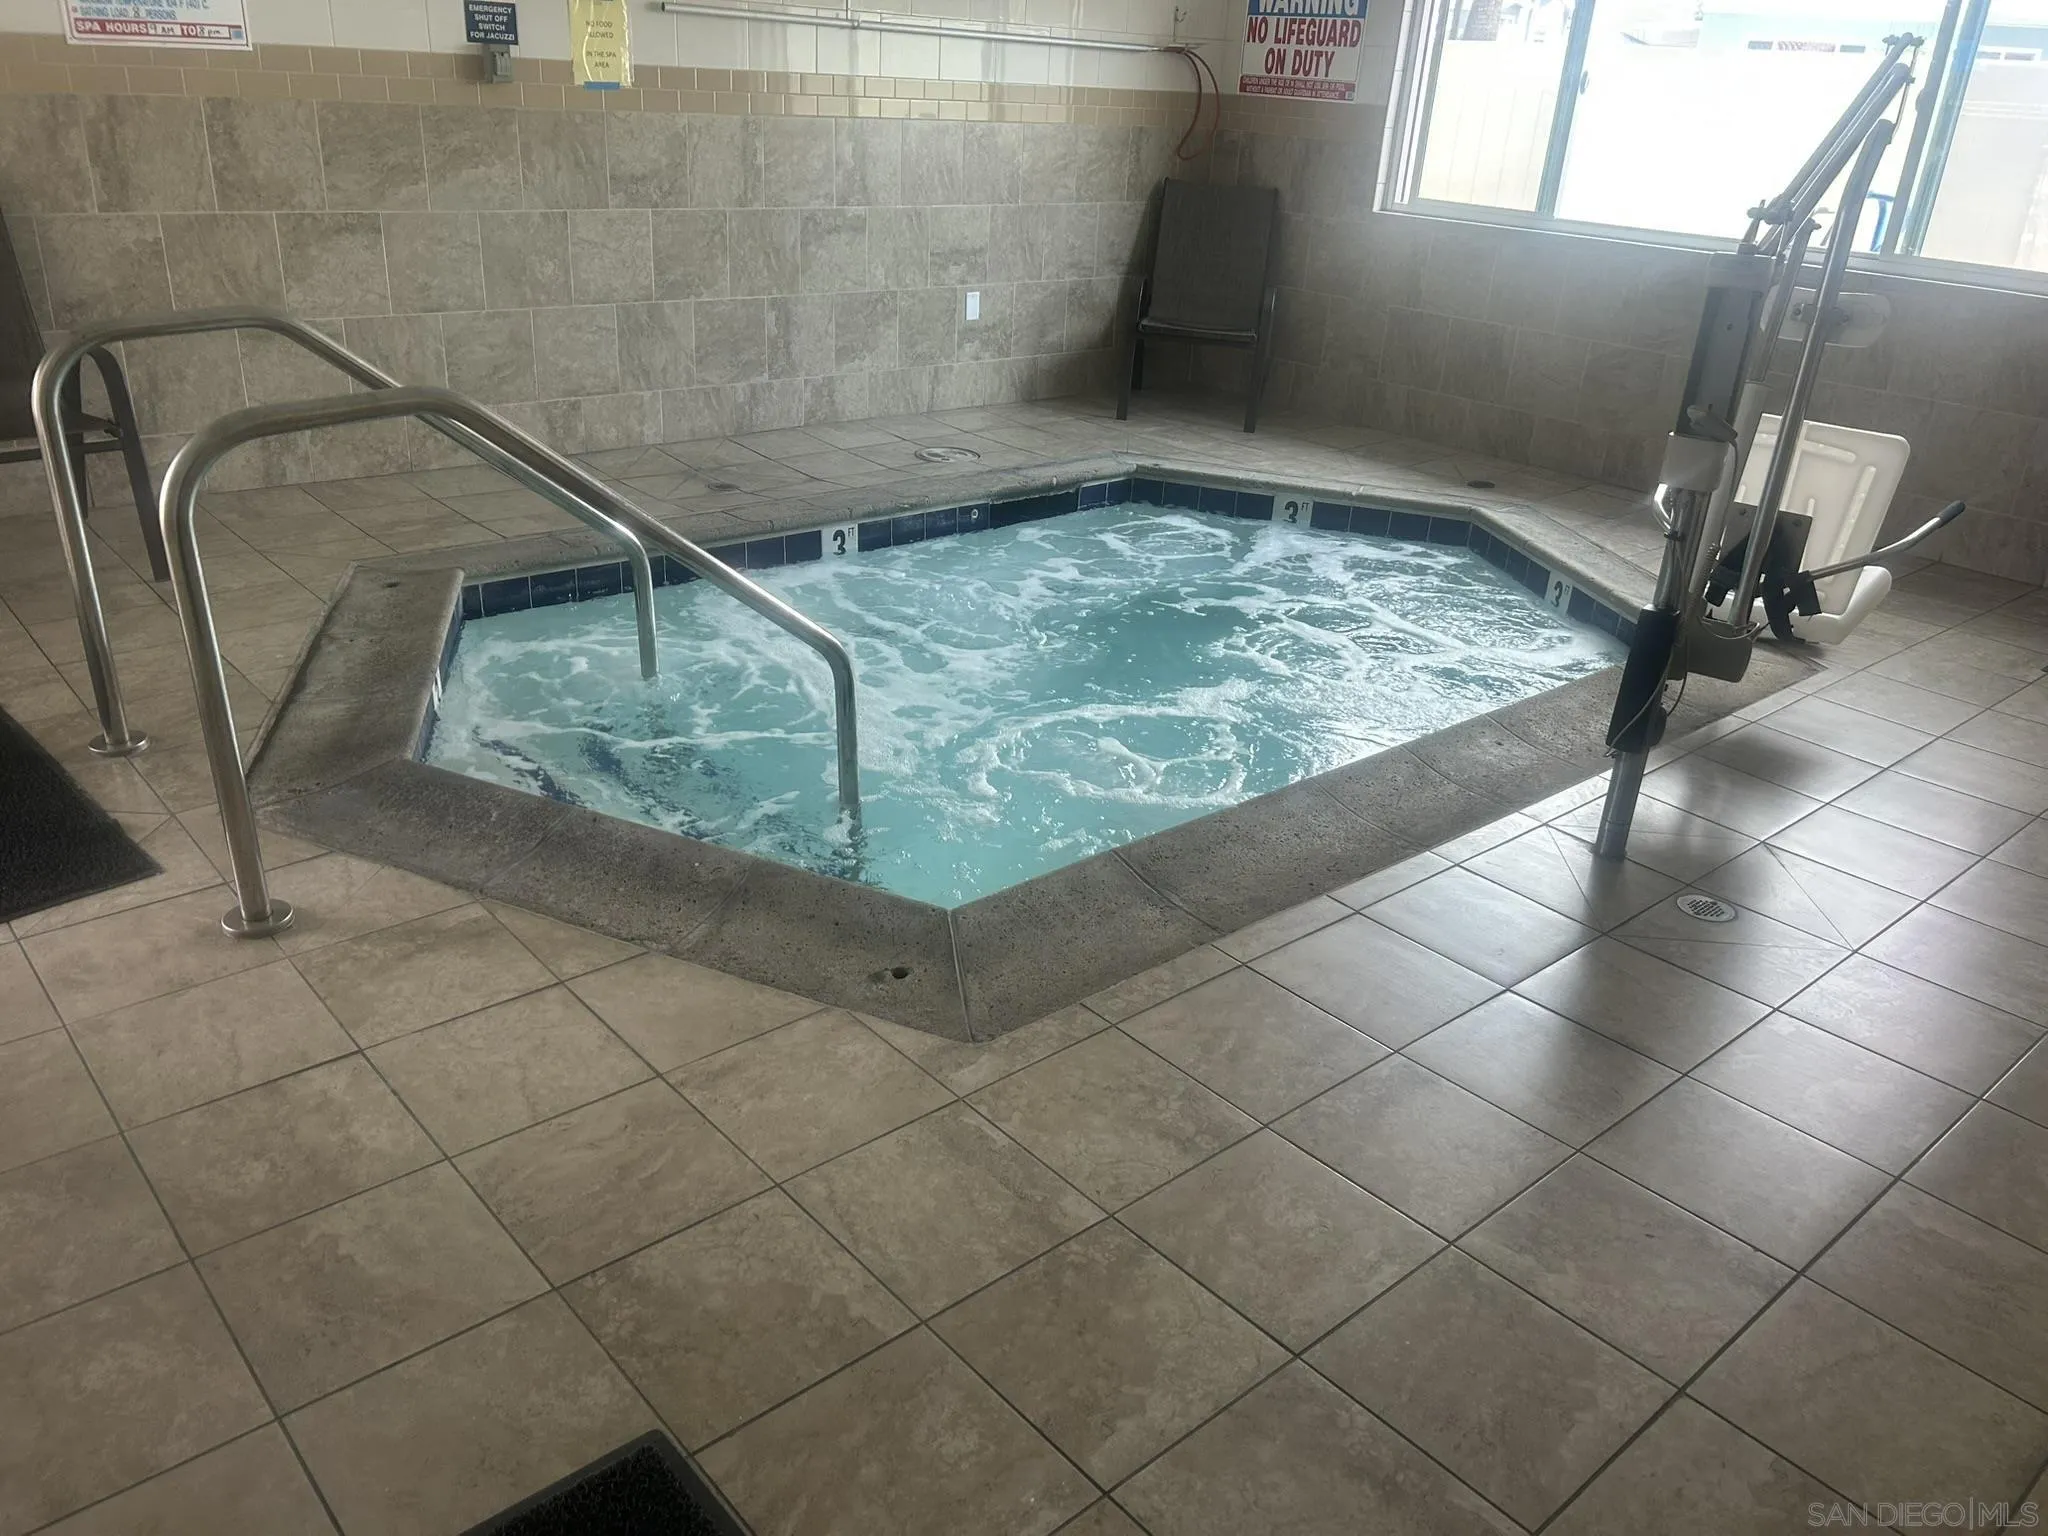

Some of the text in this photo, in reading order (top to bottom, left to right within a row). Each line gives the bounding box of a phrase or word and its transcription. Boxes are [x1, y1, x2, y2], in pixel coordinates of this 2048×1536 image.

[469, 4, 512, 13] EMERGENCY
[1258, 0, 1360, 16] WARNING
[474, 13, 493, 21] SHUT
[75, 20, 101, 32] SPA
[105, 21, 147, 33] HOURS
[181, 25, 197, 37] TO
[478, 22, 505, 31] SWITCH
[1247, 16, 1362, 47] NO LIFEGUARD
[470, 31, 515, 40] FOR JACUZZI
[1264, 47, 1335, 78] ON DUTY
[1283, 500, 1298, 524] 3
[832, 529, 846, 556] 3
[1551, 580, 1563, 608] 3
